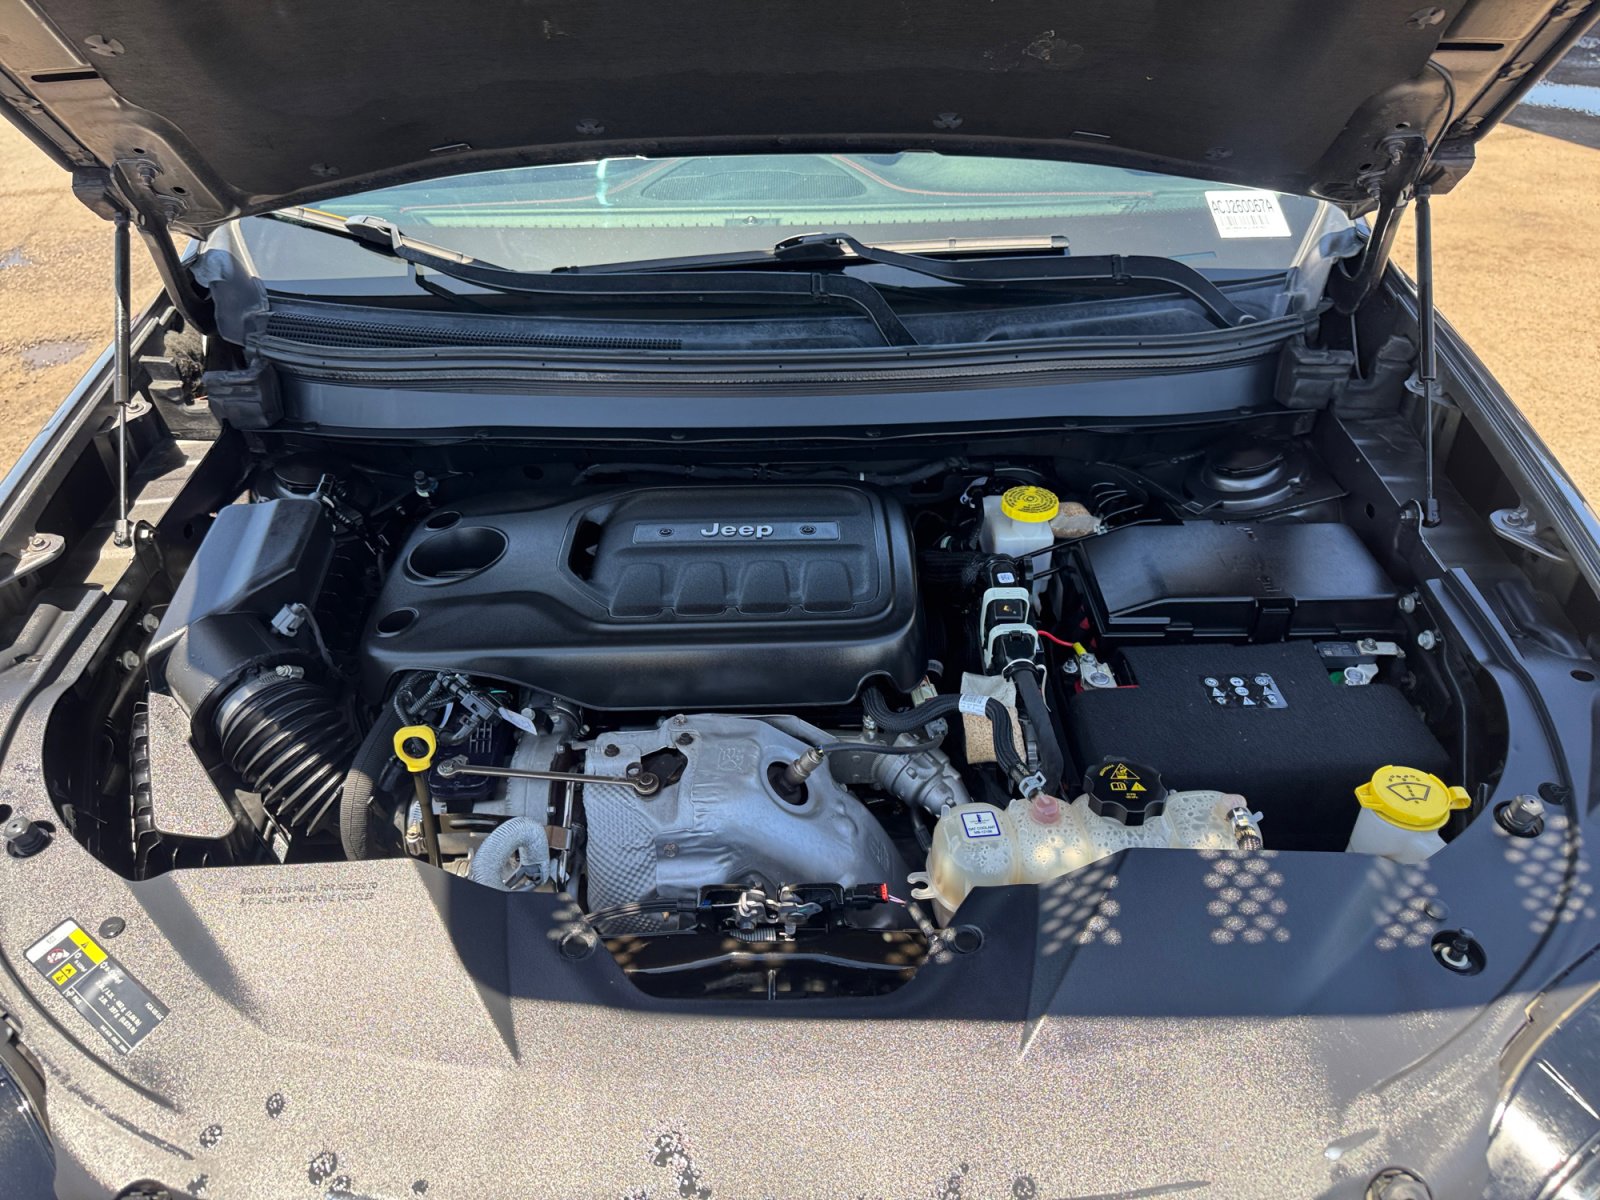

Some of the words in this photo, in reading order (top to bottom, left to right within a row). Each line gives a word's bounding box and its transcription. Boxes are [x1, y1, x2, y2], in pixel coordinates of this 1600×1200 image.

[701, 523, 774, 539] Jeep
[240, 886, 272, 895] REMOVE
[274, 885, 292, 894] THIS
[367, 881, 378, 890] TO
